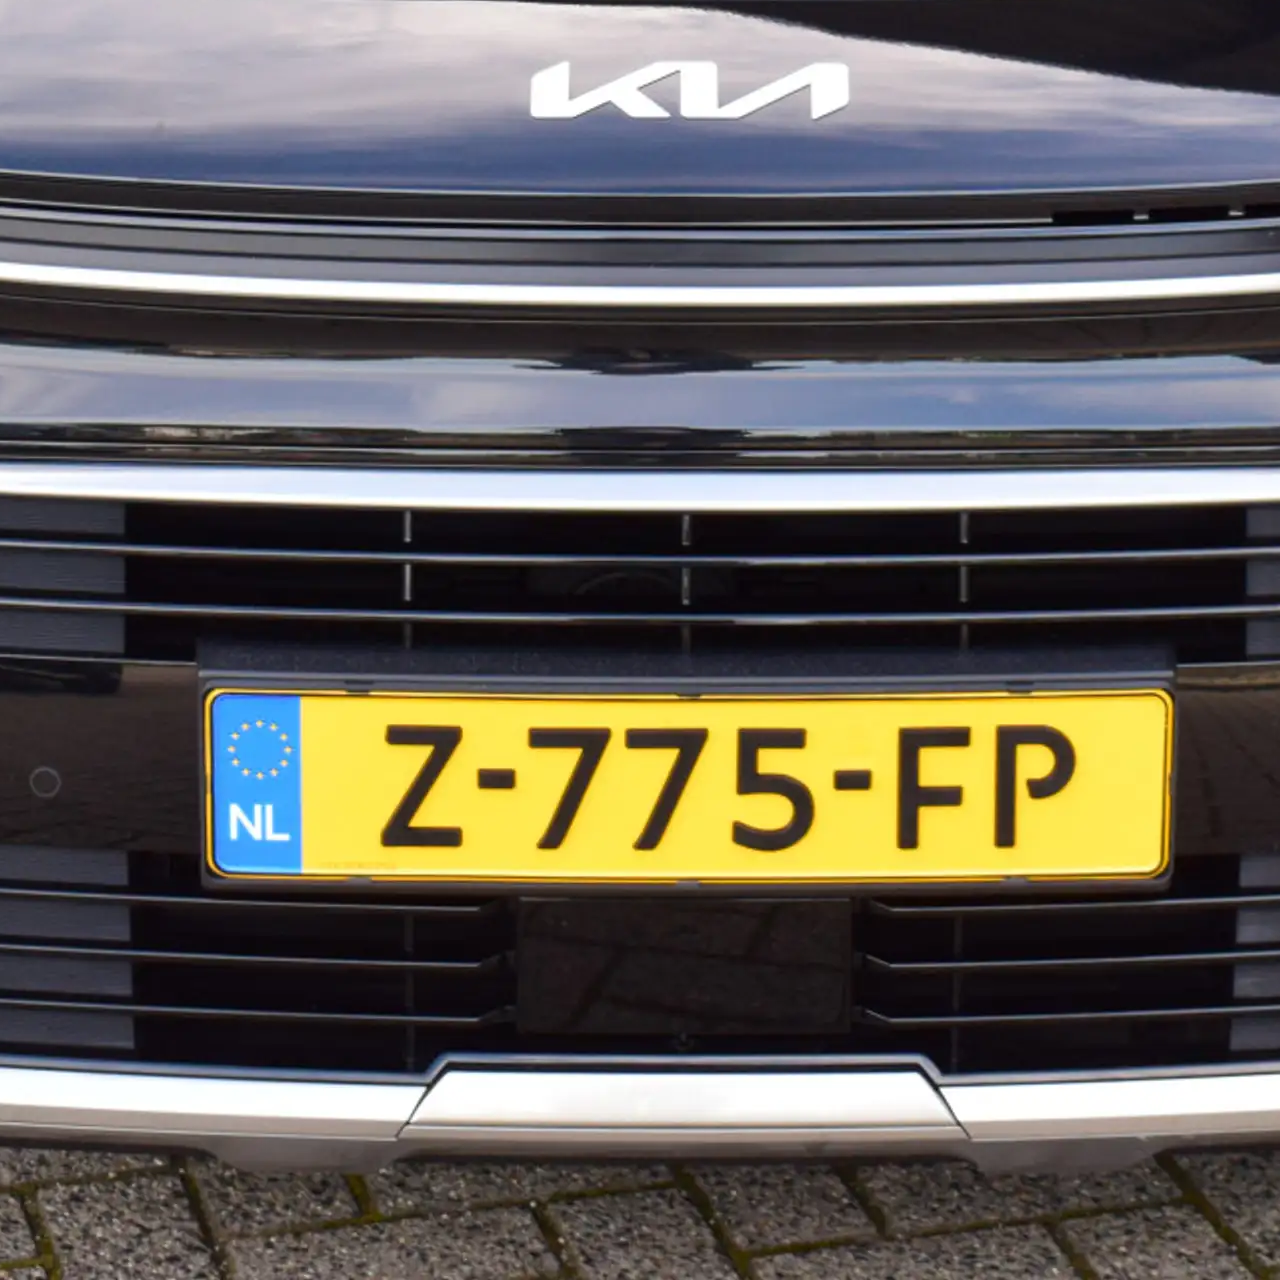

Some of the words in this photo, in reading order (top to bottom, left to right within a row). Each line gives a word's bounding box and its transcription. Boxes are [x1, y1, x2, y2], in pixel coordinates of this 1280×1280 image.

[530, 60, 850, 120] KIA
[380, 724, 1077, 851] Z-775-FP
[229, 803, 291, 842] NL
